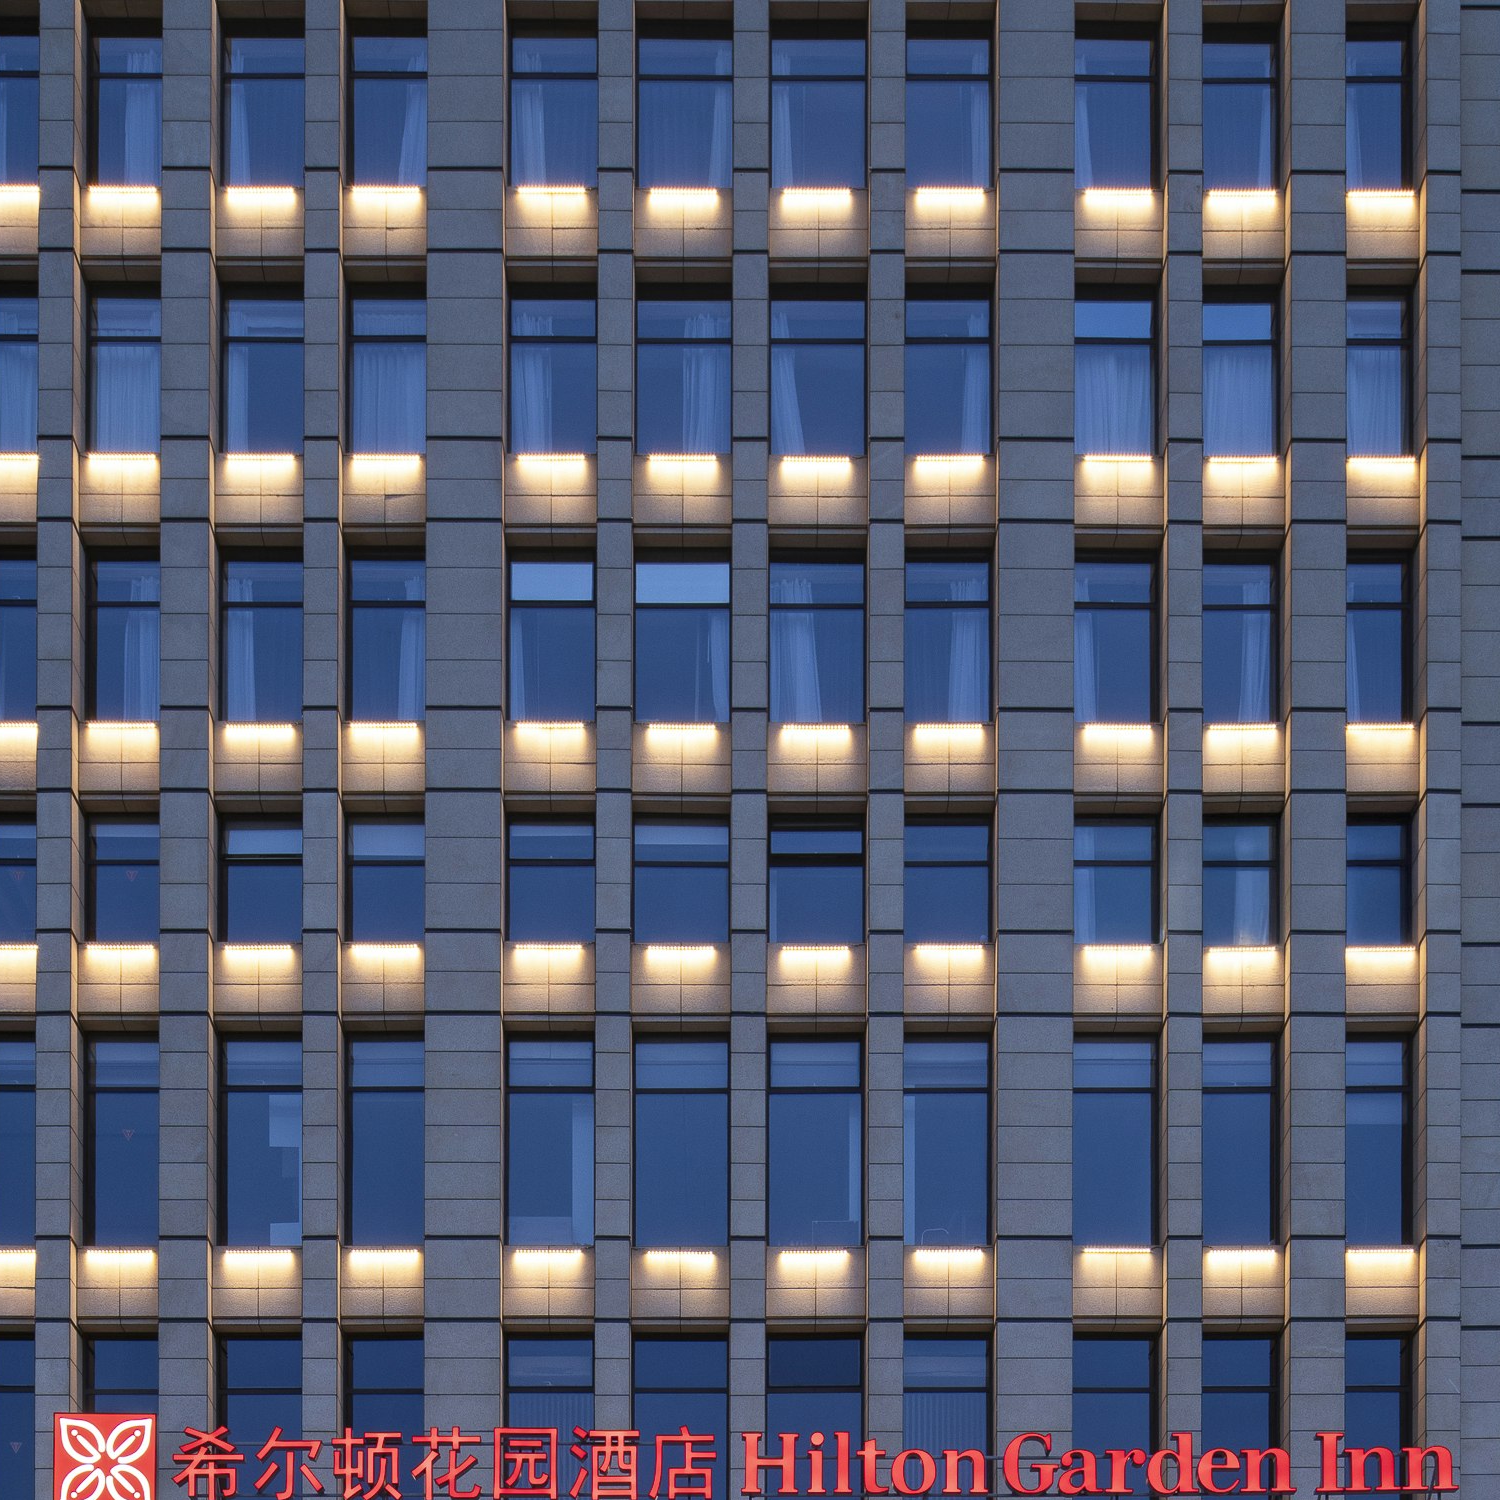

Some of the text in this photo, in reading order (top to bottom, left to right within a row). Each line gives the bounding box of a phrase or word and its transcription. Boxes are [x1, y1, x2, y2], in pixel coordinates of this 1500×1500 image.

[740, 1431, 1460, 1495] Hilton Garden Inn
